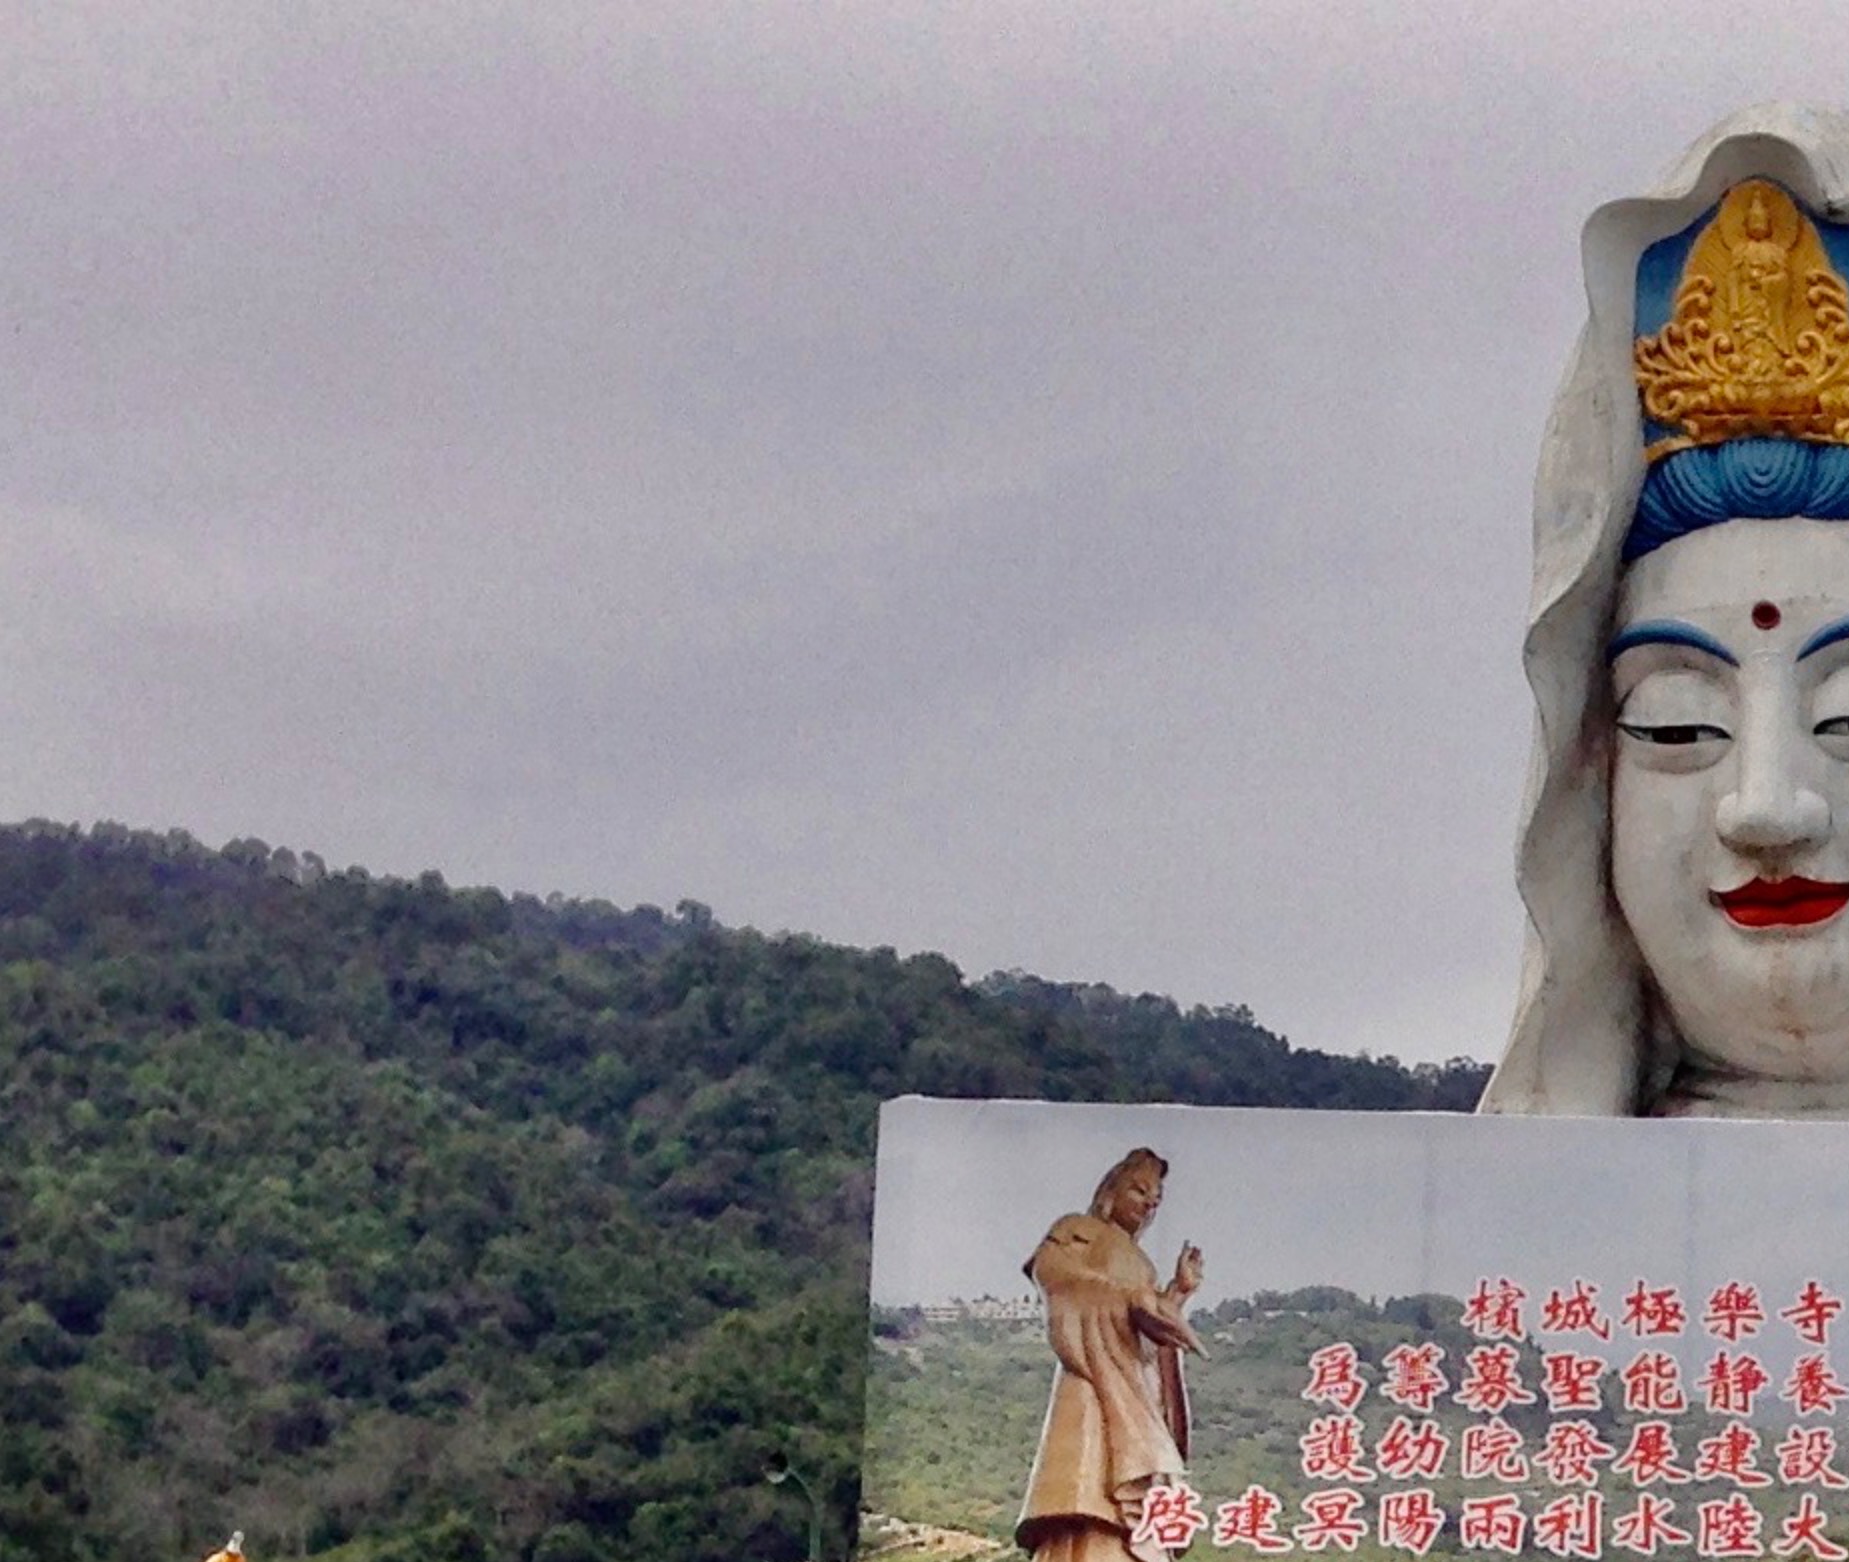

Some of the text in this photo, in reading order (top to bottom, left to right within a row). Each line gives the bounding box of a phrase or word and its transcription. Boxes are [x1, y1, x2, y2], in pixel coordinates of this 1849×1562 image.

[1463, 1277, 1843, 1347] 檳城極樂寺
